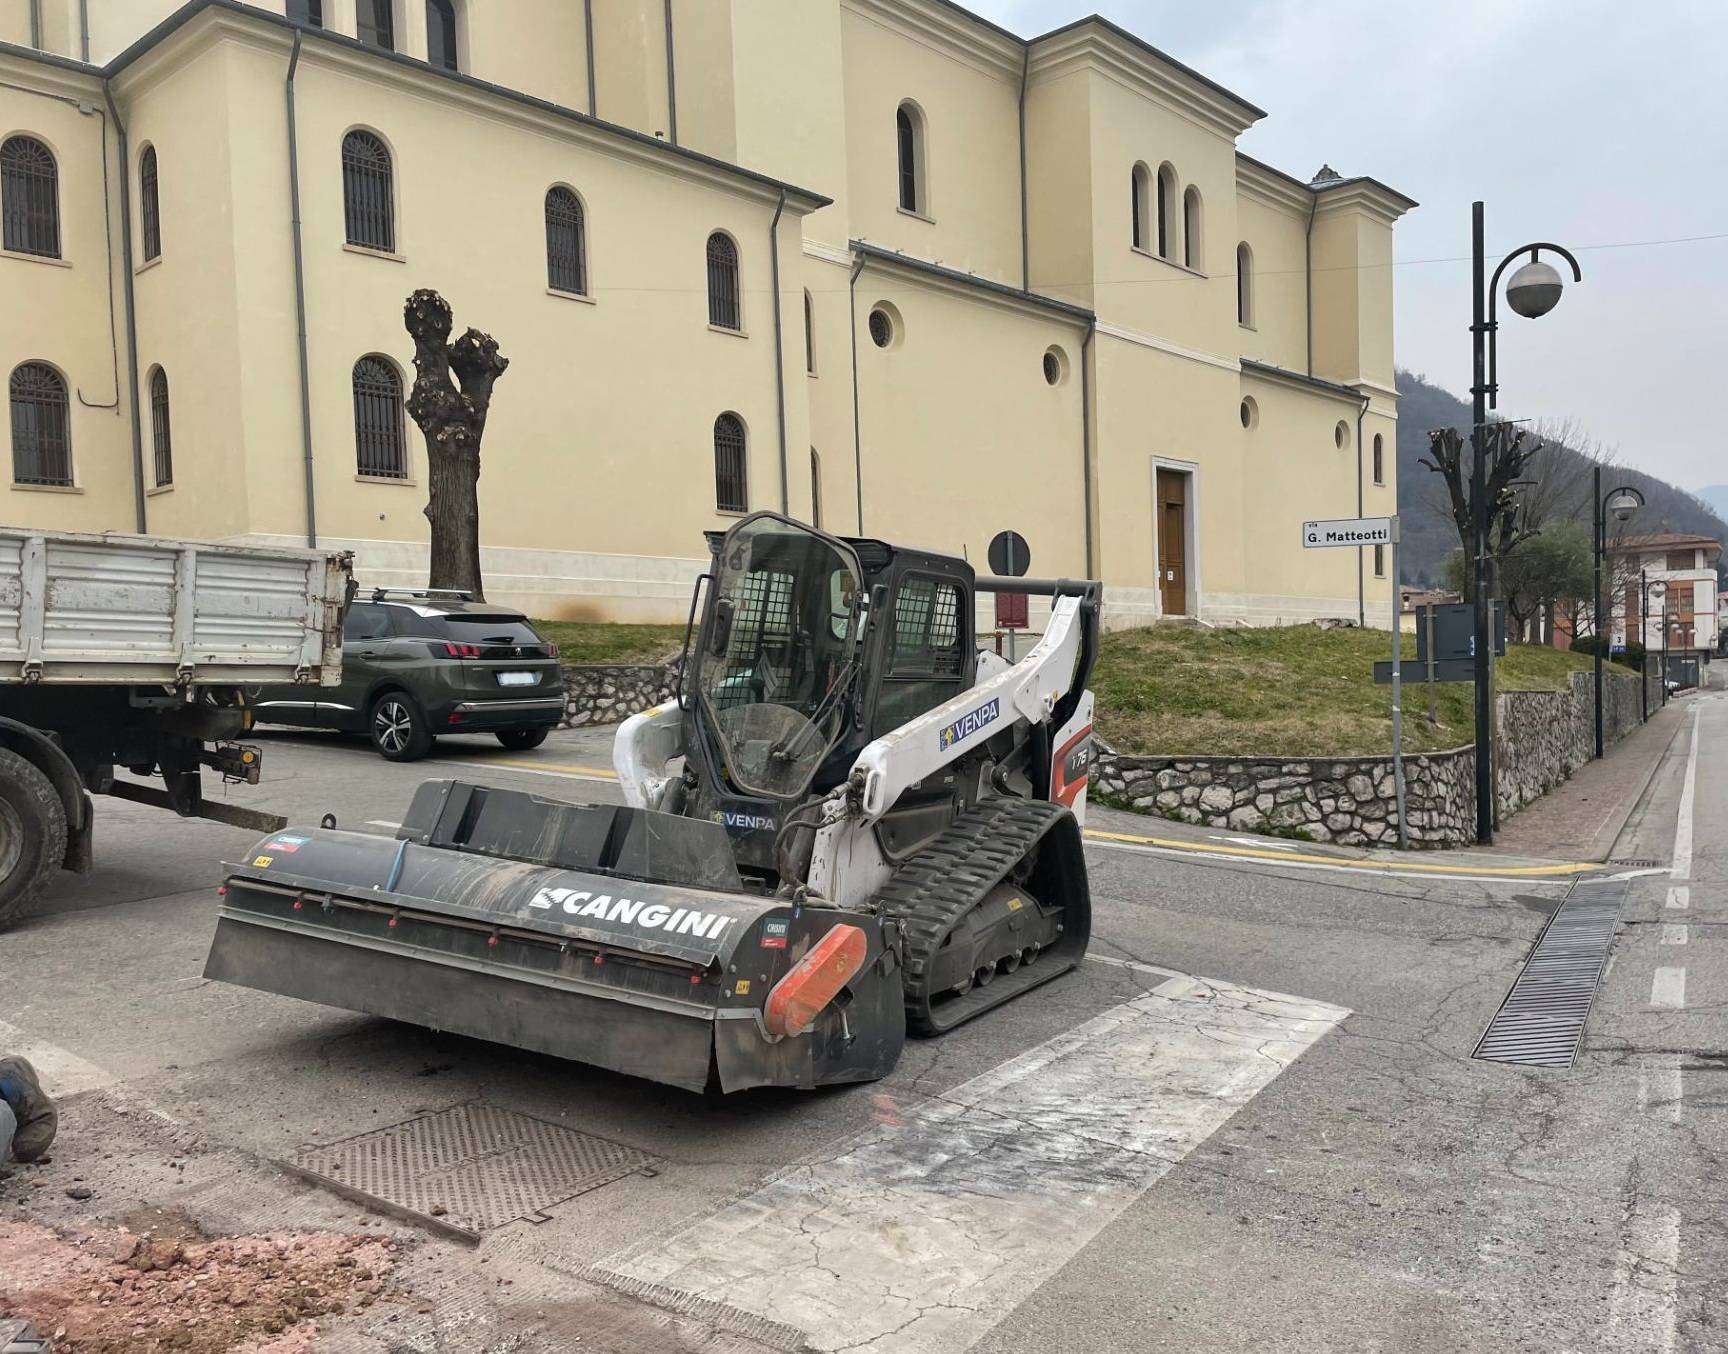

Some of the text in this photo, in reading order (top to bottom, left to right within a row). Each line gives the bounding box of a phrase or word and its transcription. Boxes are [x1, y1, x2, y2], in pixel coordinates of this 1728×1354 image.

[1308, 529, 1387, 542] G. Matteotti
[955, 701, 998, 739] VENPA
[726, 812, 775, 831] VENPA
